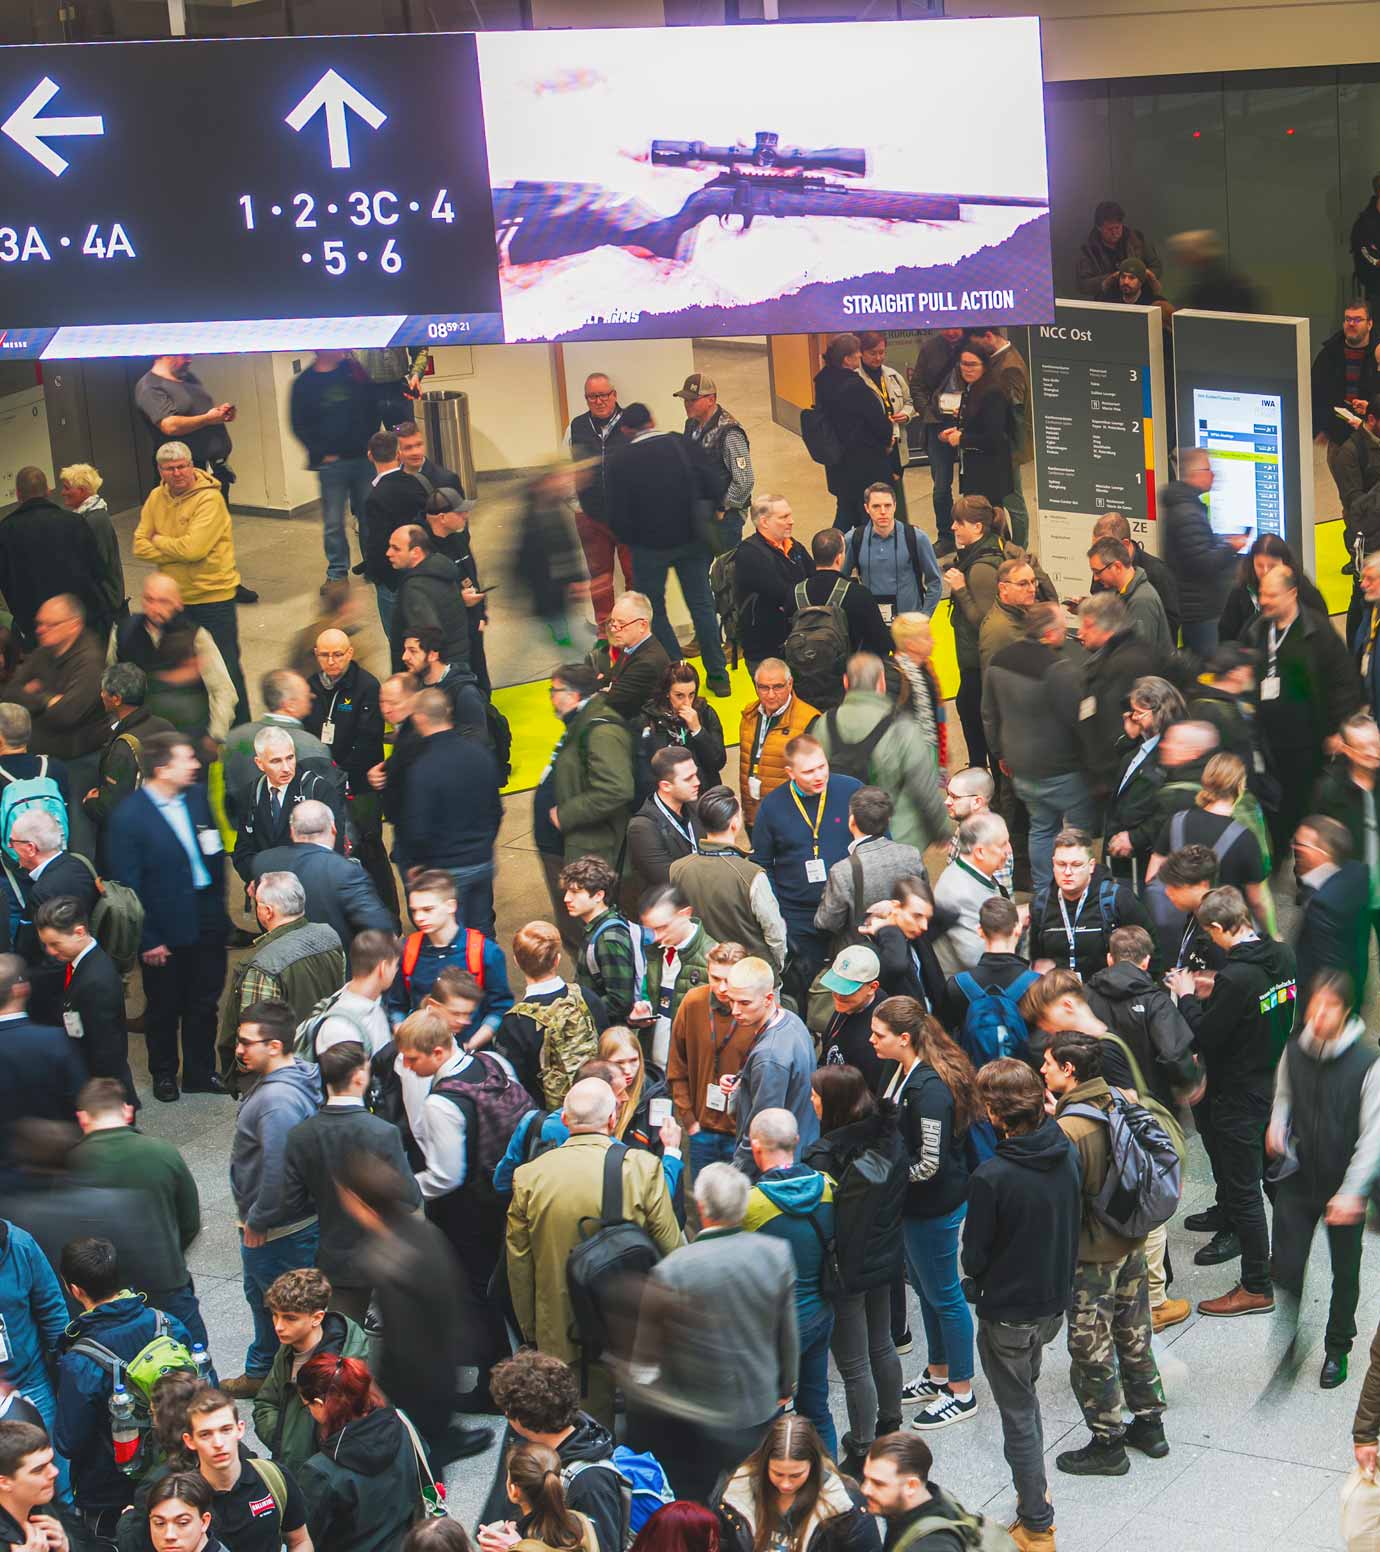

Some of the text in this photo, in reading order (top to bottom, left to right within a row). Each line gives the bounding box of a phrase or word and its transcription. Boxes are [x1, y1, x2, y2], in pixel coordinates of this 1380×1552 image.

[239, 189, 455, 230] 1 2 3C 4
[0, 223, 136, 262] 3A 4A
[323, 239, 402, 275] 5 6
[842, 289, 1015, 315] STRAIGHT PULL ACTION
[1040, 325, 1093, 342] NCC Ost
[1129, 369, 1138, 382] 3
[1261, 399, 1276, 408] IWA
[1132, 421, 1141, 433] 2
[1135, 473, 1142, 485] 1
[1132, 521, 1148, 534] ZE
